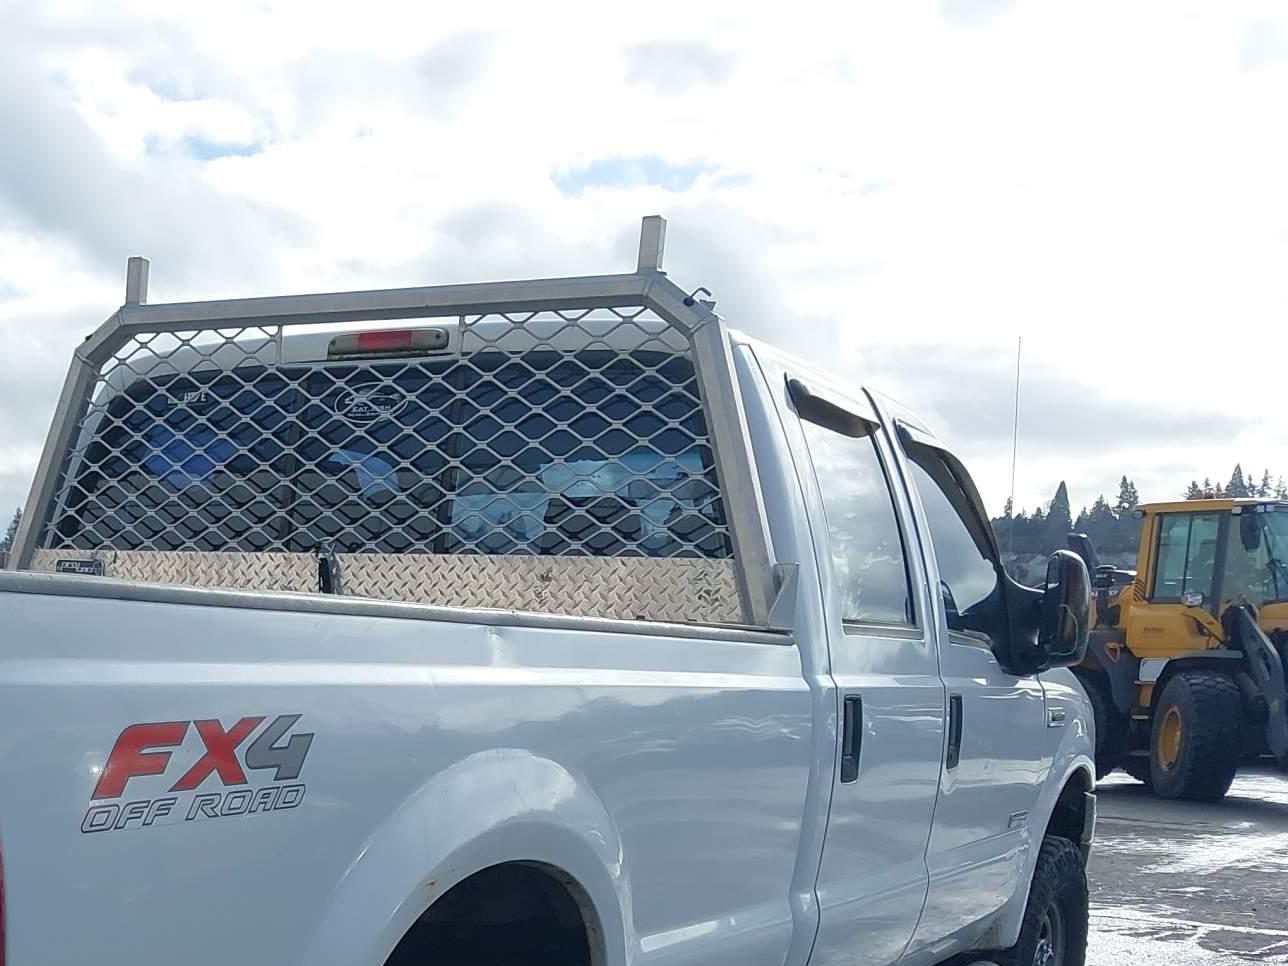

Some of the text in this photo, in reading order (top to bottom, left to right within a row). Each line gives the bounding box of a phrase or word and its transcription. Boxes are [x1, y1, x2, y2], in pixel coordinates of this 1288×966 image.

[91, 713, 315, 801] FX4
[80, 783, 307, 834] OFF ROAD
